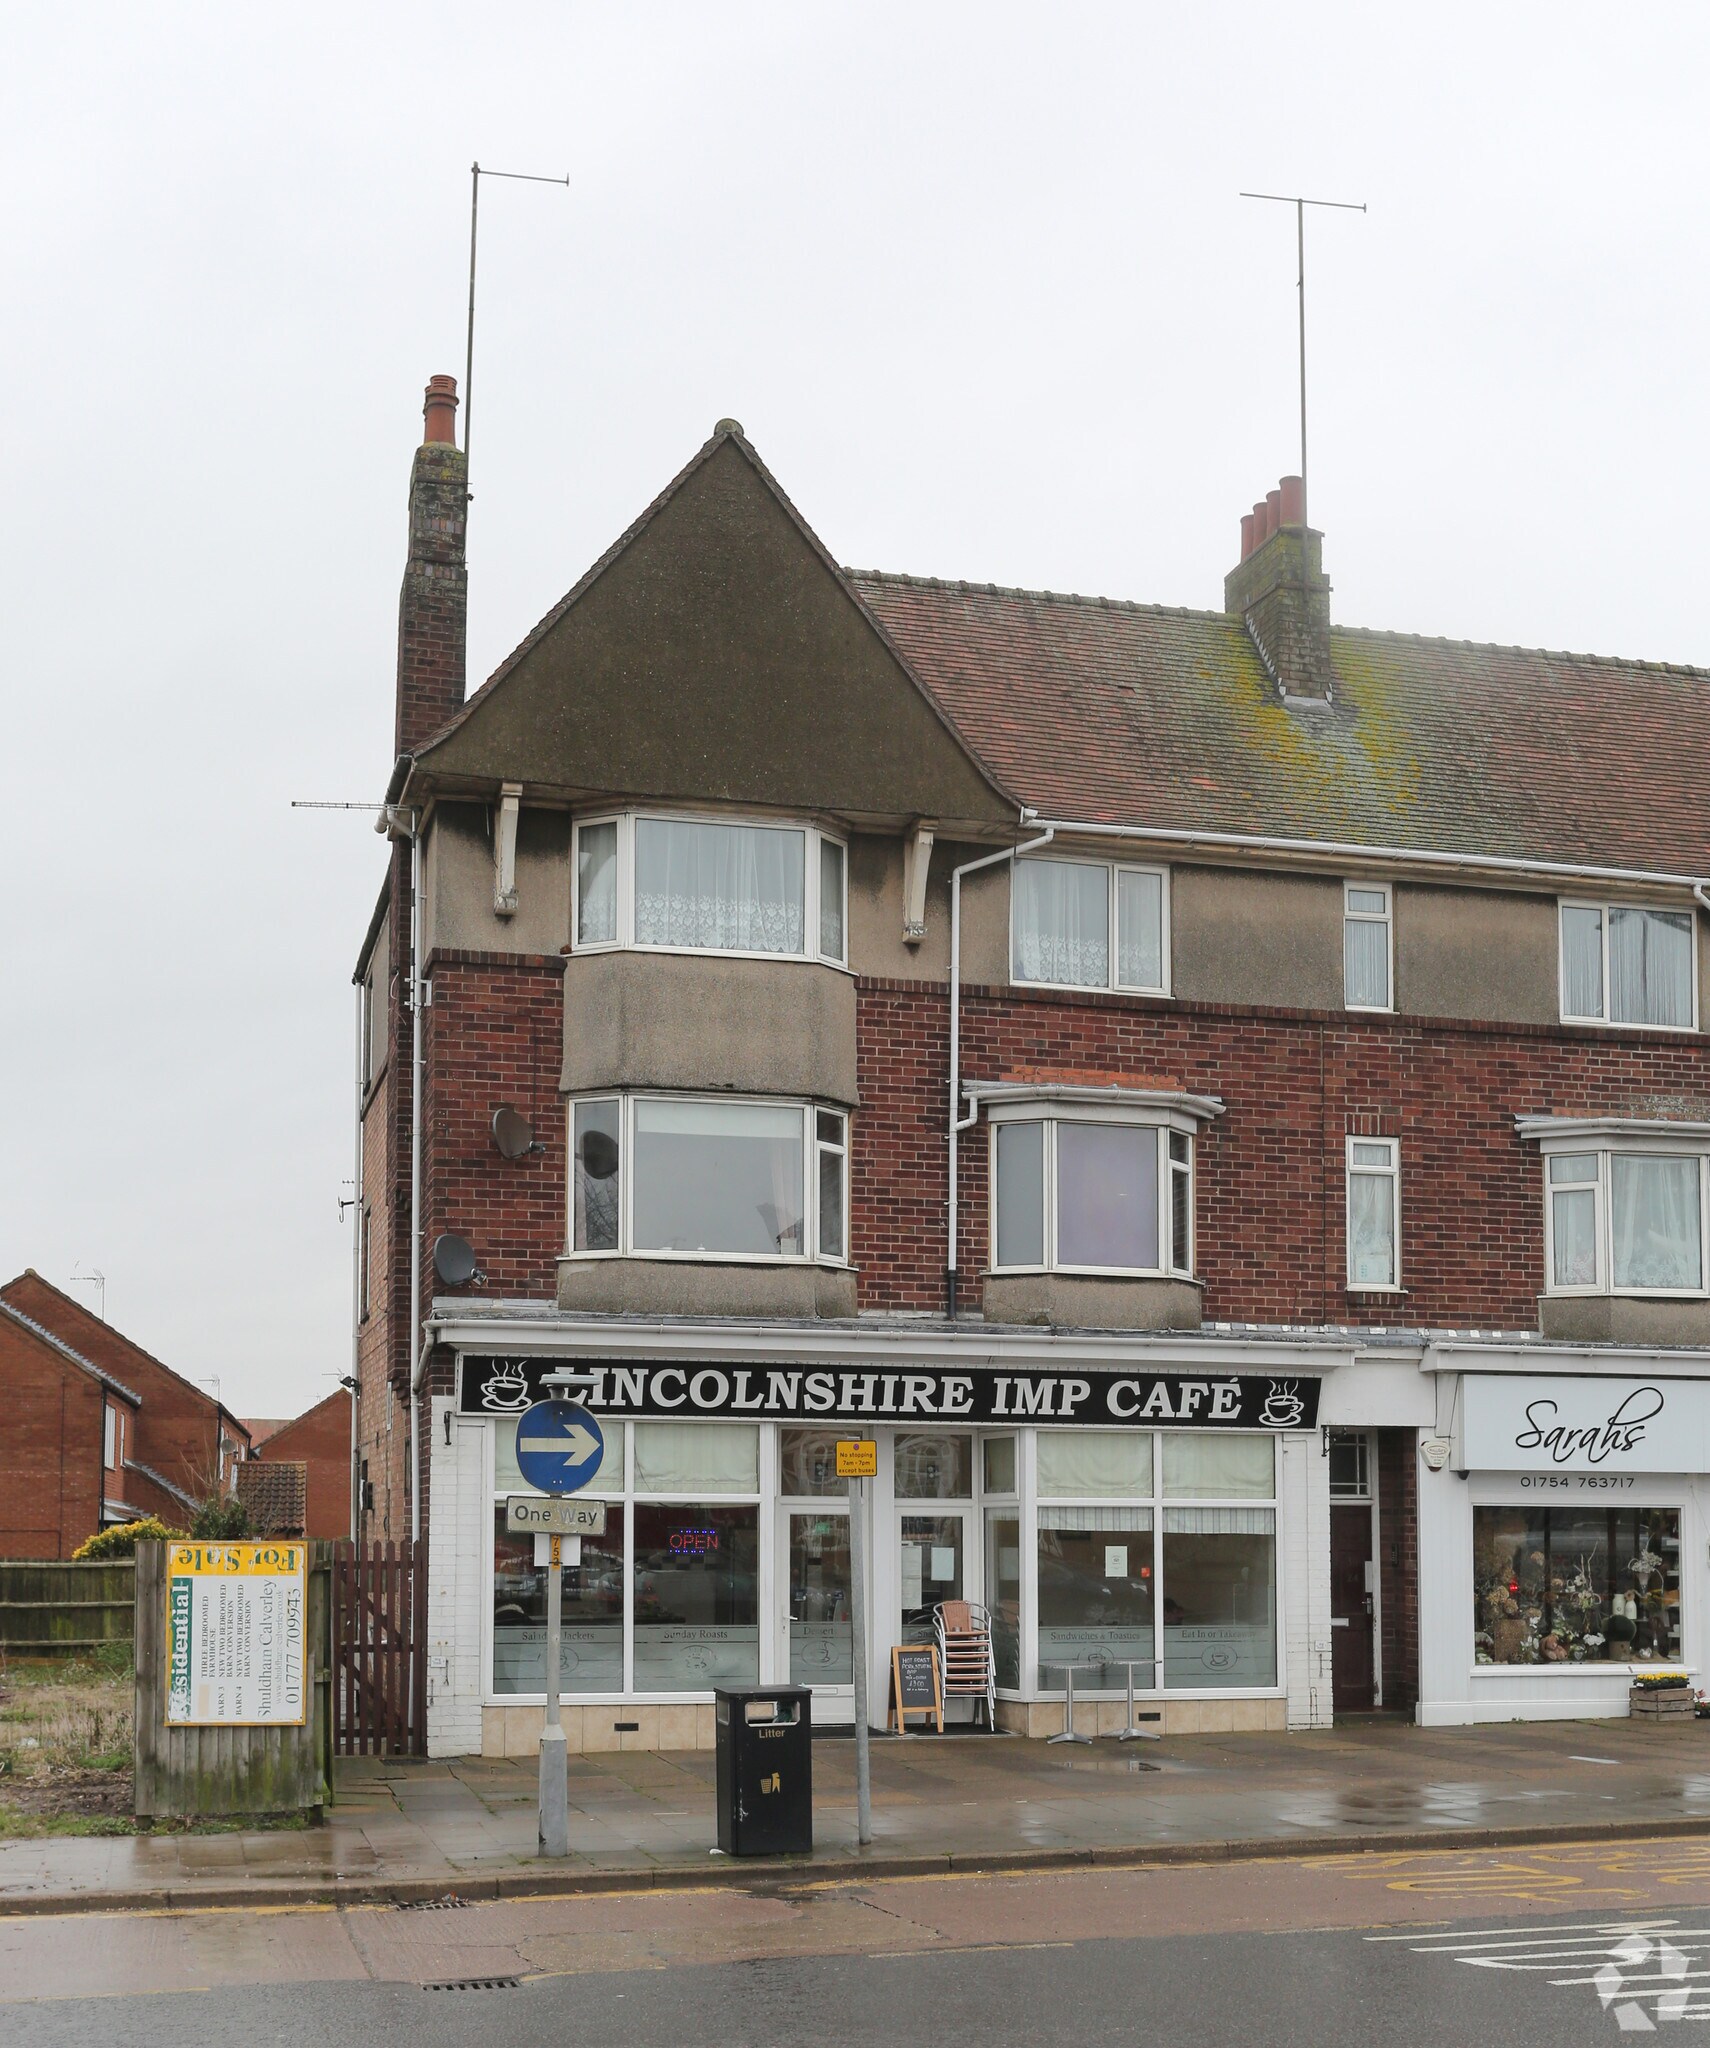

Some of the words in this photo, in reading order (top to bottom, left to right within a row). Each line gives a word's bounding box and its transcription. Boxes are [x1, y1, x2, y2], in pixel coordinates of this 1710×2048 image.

[554, 1366, 975, 1414] LINCOLNSHIRE
[991, 1377, 1091, 1416] IMP
[1106, 1377, 1243, 1420] CAFÉ
[849, 1451, 873, 1459] stopping
[1520, 1476, 1569, 1488] 01754
[1578, 1477, 1635, 1488] 763717
[514, 1505, 552, 1521] One
[560, 1507, 598, 1526] Way
[669, 1534, 719, 1549] OPEN
[178, 1549, 241, 1572] Sale
[249, 1549, 297, 1572] For
[258, 1579, 276, 1646] Calverley
[563, 1631, 595, 1641] Jackets
[664, 1630, 698, 1641] Sunday
[699, 1630, 728, 1639] Roasts
[1050, 1631, 1098, 1641] Sandwiches
[1107, 1631, 1140, 1640] Toasties
[1181, 1630, 1195, 1638] Eat
[1197, 1630, 1206, 1638] In
[258, 1649, 273, 1717] Shuldham
[285, 1654, 301, 1705] 01777
[758, 1728, 785, 1739] Litter
